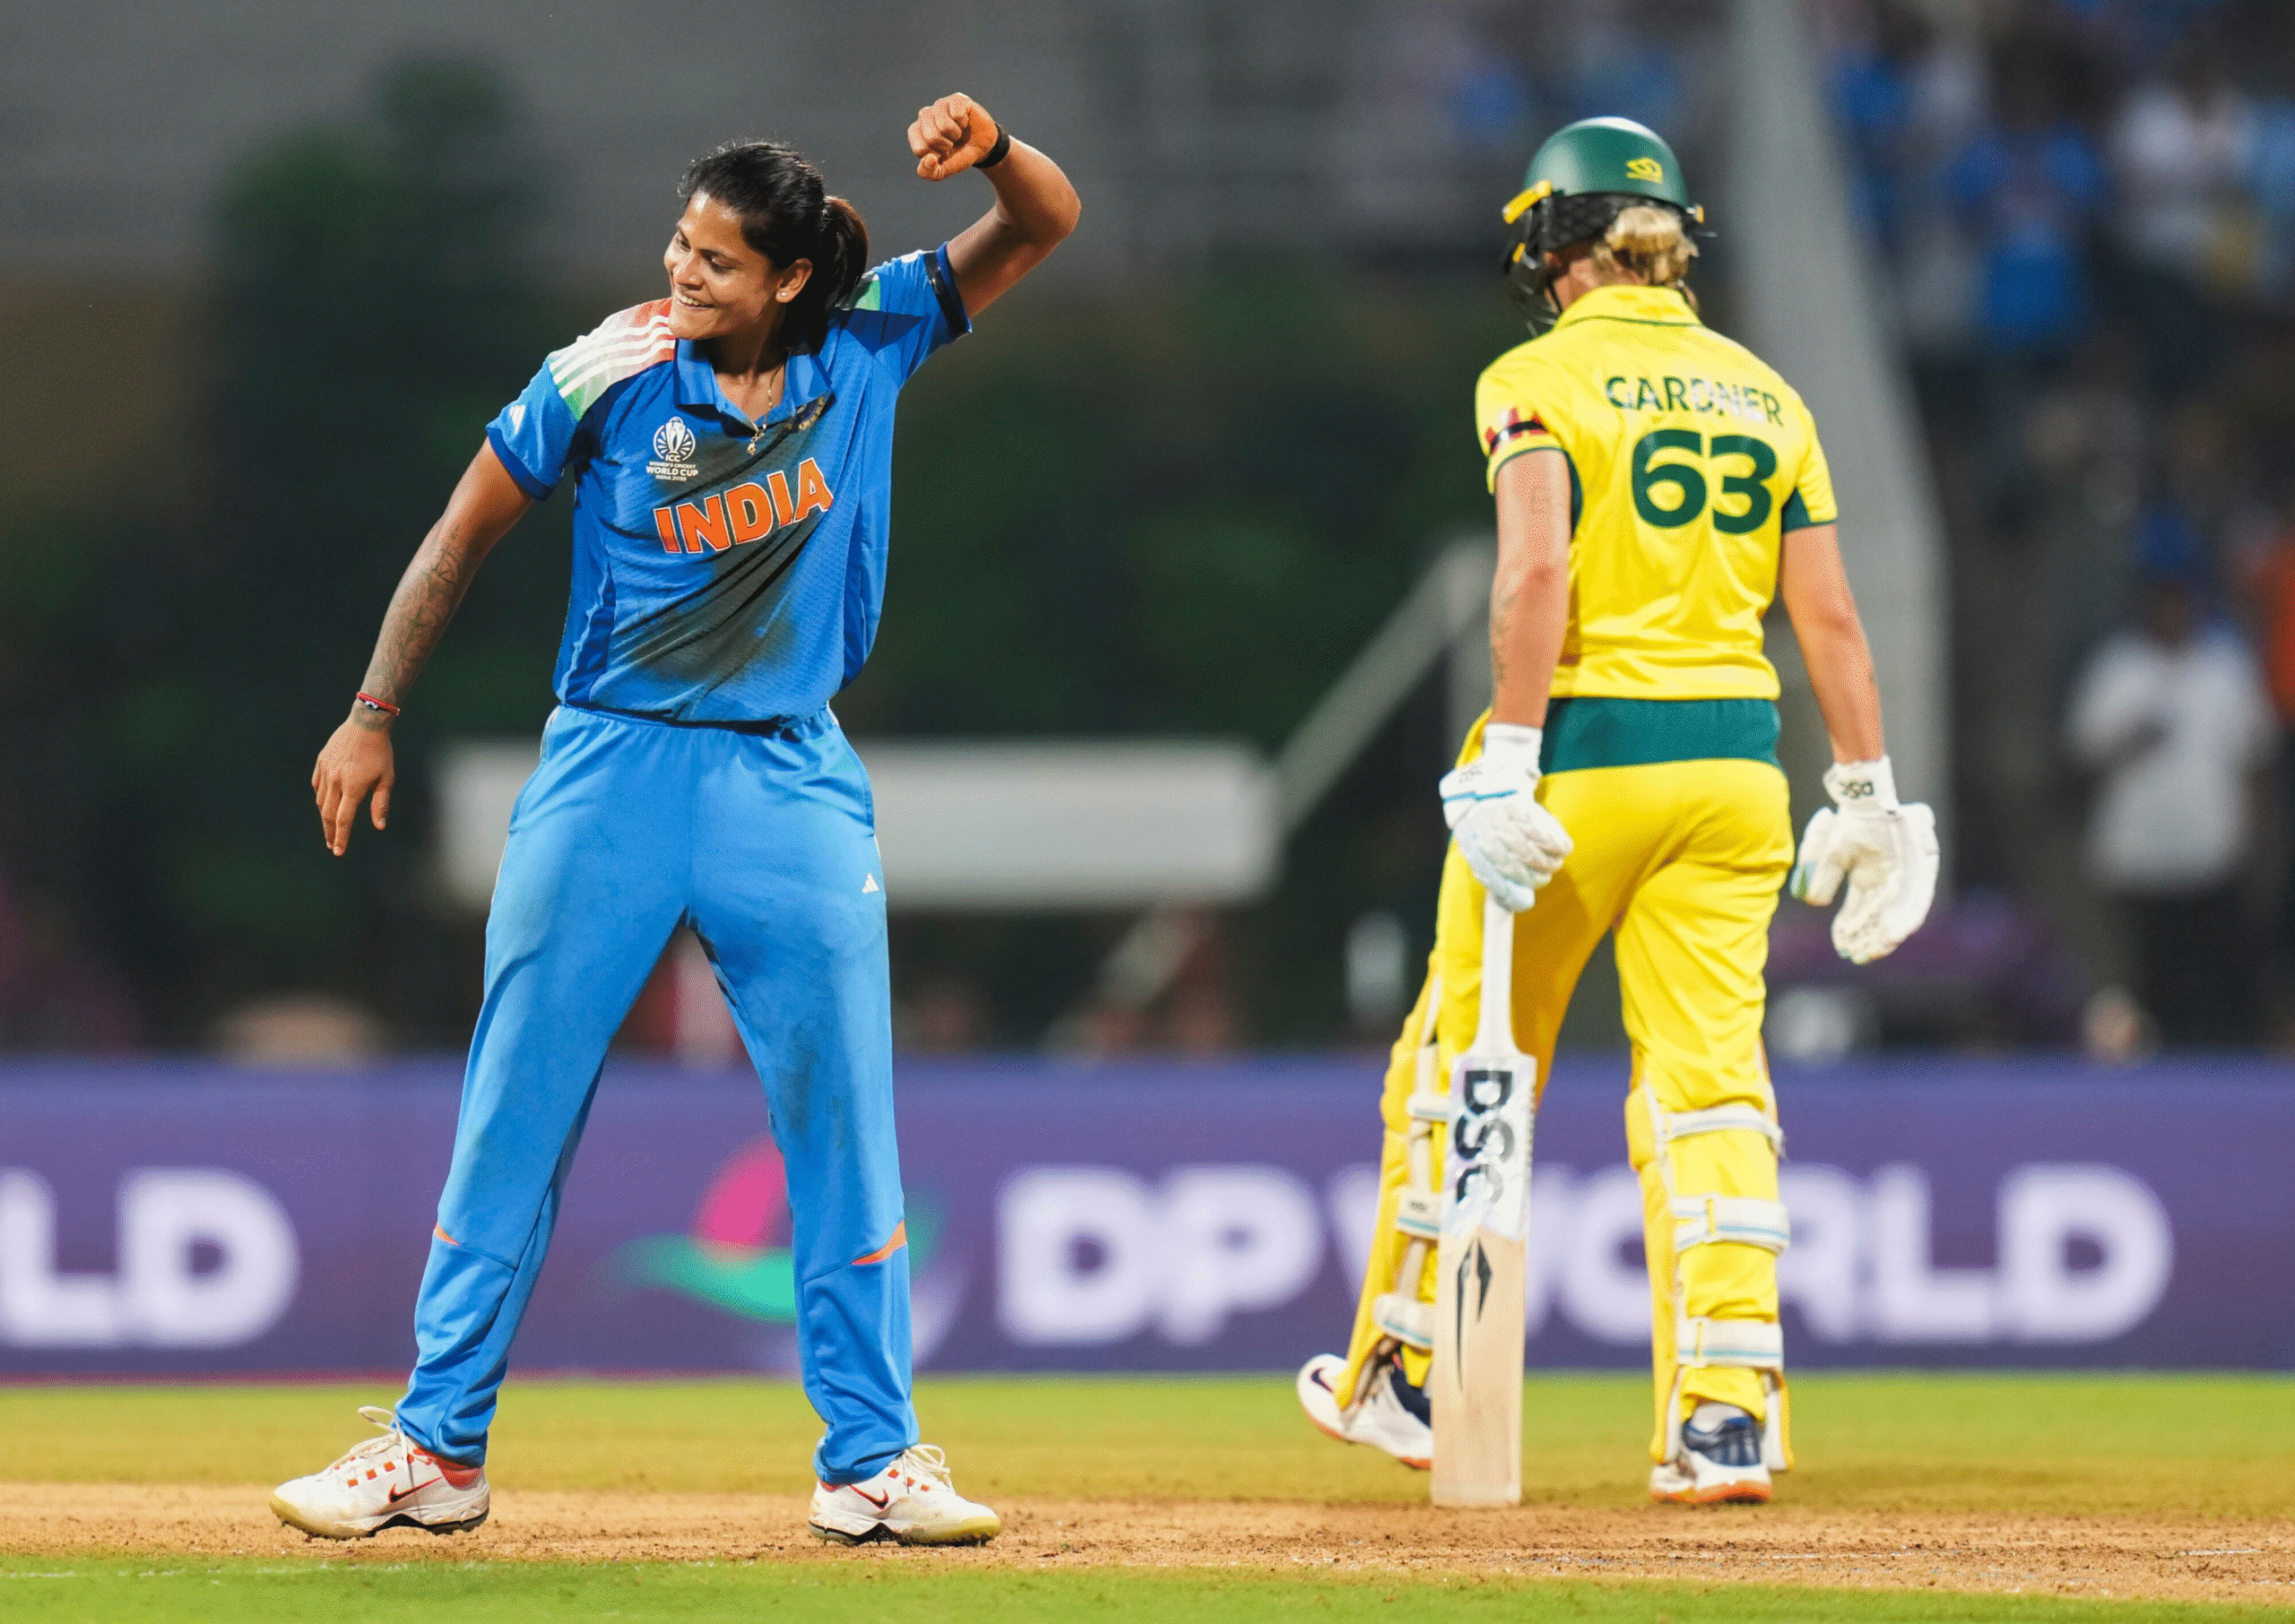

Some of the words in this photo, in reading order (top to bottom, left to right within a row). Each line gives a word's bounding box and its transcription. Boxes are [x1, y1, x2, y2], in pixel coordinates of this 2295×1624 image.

[1605, 376, 1785, 428] GARDNER
[646, 466, 679, 475] WORLD
[680, 469, 698, 477] CUP
[654, 457, 834, 554] INDIA
[665, 454, 680, 462] ICC
[1631, 428, 1778, 536] 63
[1454, 1069, 1515, 1205] DSC
[997, 1166, 1321, 1346] DP
